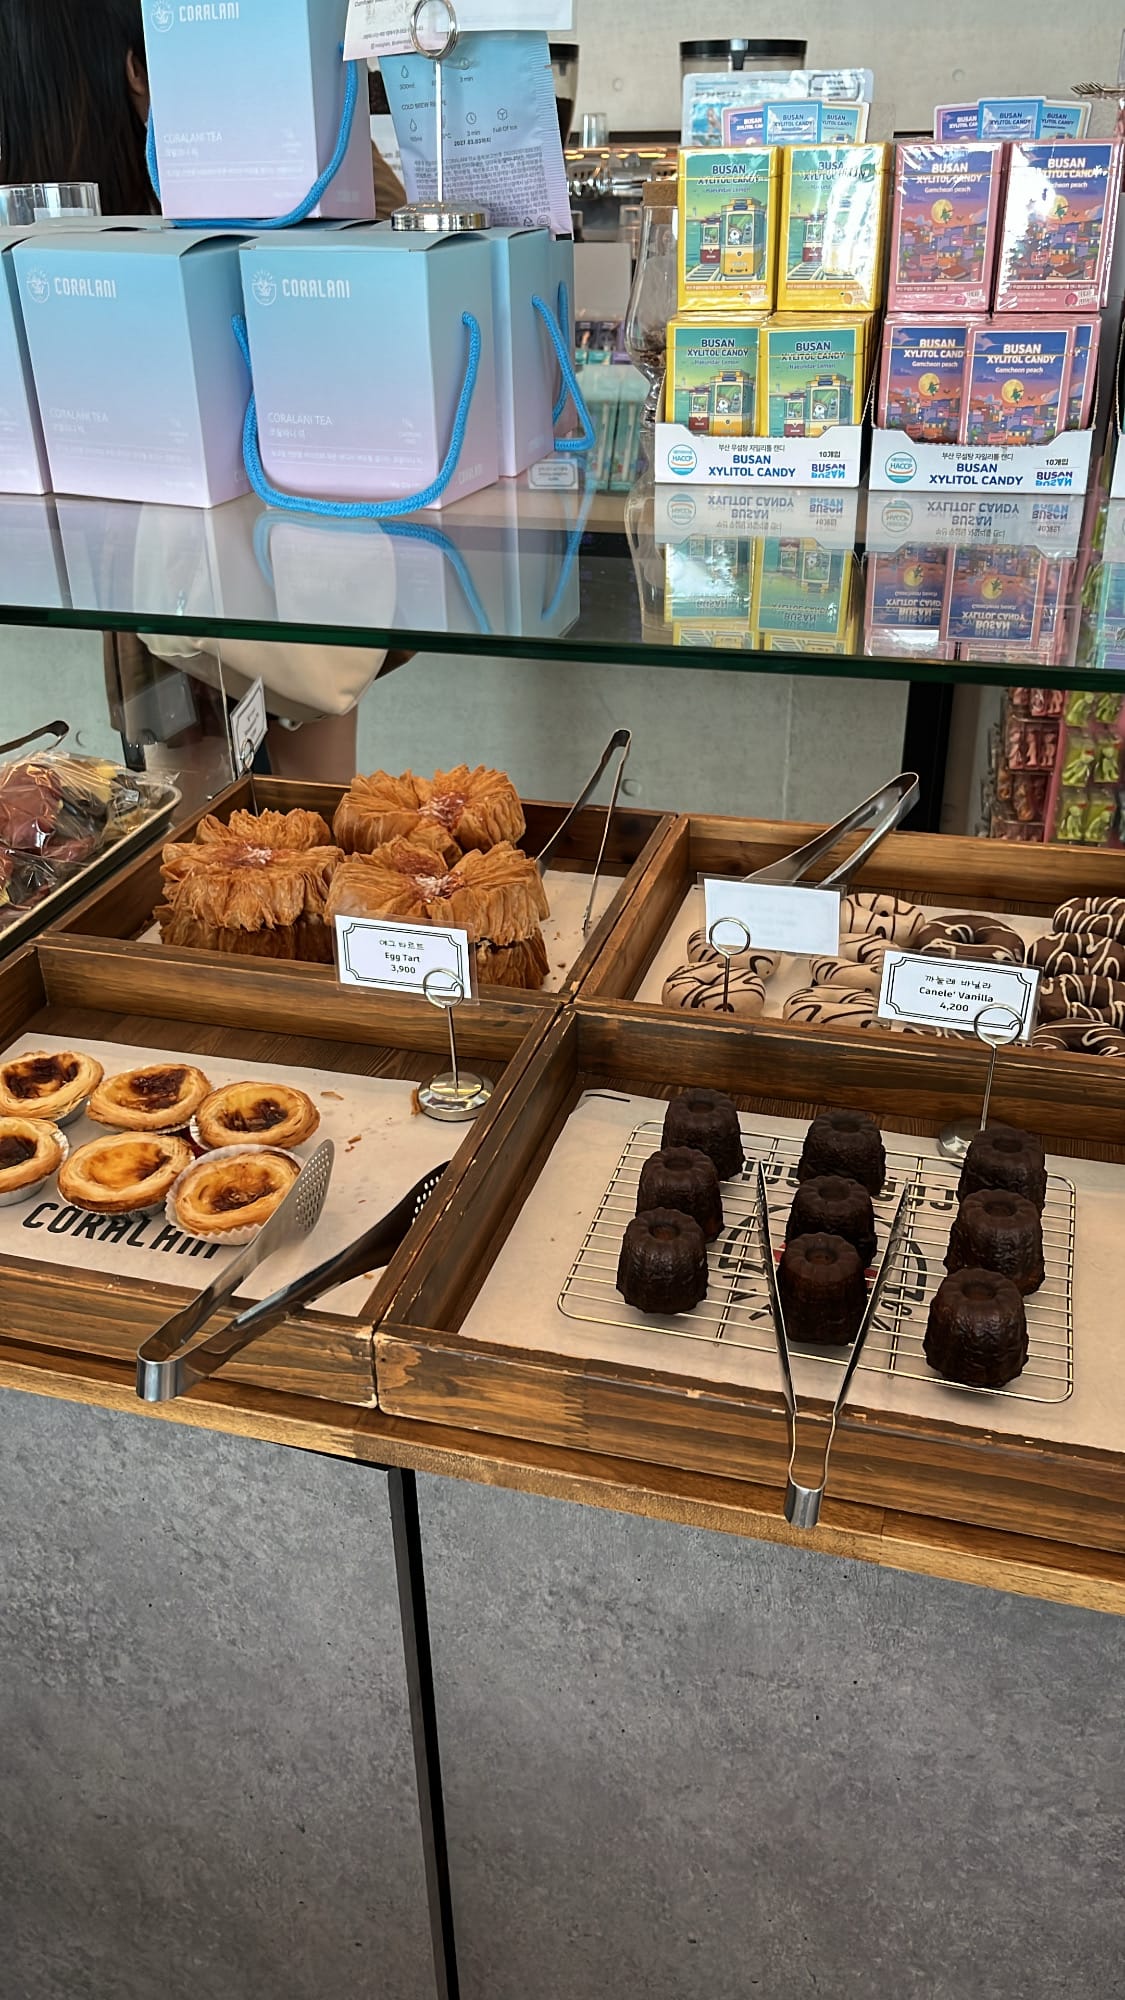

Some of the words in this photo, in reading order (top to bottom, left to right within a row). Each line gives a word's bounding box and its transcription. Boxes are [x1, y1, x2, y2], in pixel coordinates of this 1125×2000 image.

[179, 2, 239, 22] CORALANI
[932, 163, 968, 173] BUSAN
[1048, 158, 1085, 169] BUSAN
[712, 165, 745, 175] BUSAN
[54, 277, 117, 298] CORALANI
[282, 279, 350, 298] CORALANI
[701, 339, 735, 348] BUSAN
[795, 342, 831, 352] BUSAN
[919, 339, 956, 348] BUSAN
[687, 349, 719, 357] XYLITOL
[722, 349, 749, 357] CANDY
[904, 350, 938, 358] XYLITOL
[940, 350, 964, 358] CAND
[1003, 344, 1041, 354] BUSAN
[986, 356, 1023, 364] XYLITOL
[1025, 355, 1056, 364] CANDY
[1026, 367, 1044, 375] peach
[718, 444, 730, 452] 부산
[733, 455, 771, 464] BUSAN
[942, 452, 954, 460] 부산
[1046, 458, 1069, 466] 10개입
[709, 467, 754, 477] XYLITOL
[757, 467, 796, 477] CANDY
[957, 463, 997, 473] BUSAN
[929, 475, 978, 485] XYLITOL
[981, 476, 1023, 486] CANDY
[398, 942, 424, 950] 타르트
[385, 952, 401, 962] Egg
[403, 954, 420, 962] Tart
[391, 965, 416, 974] 3,900
[961, 980, 992, 989] 바닐라
[959, 991, 994, 1003] Vanilla
[940, 1002, 969, 1012] 4,200
